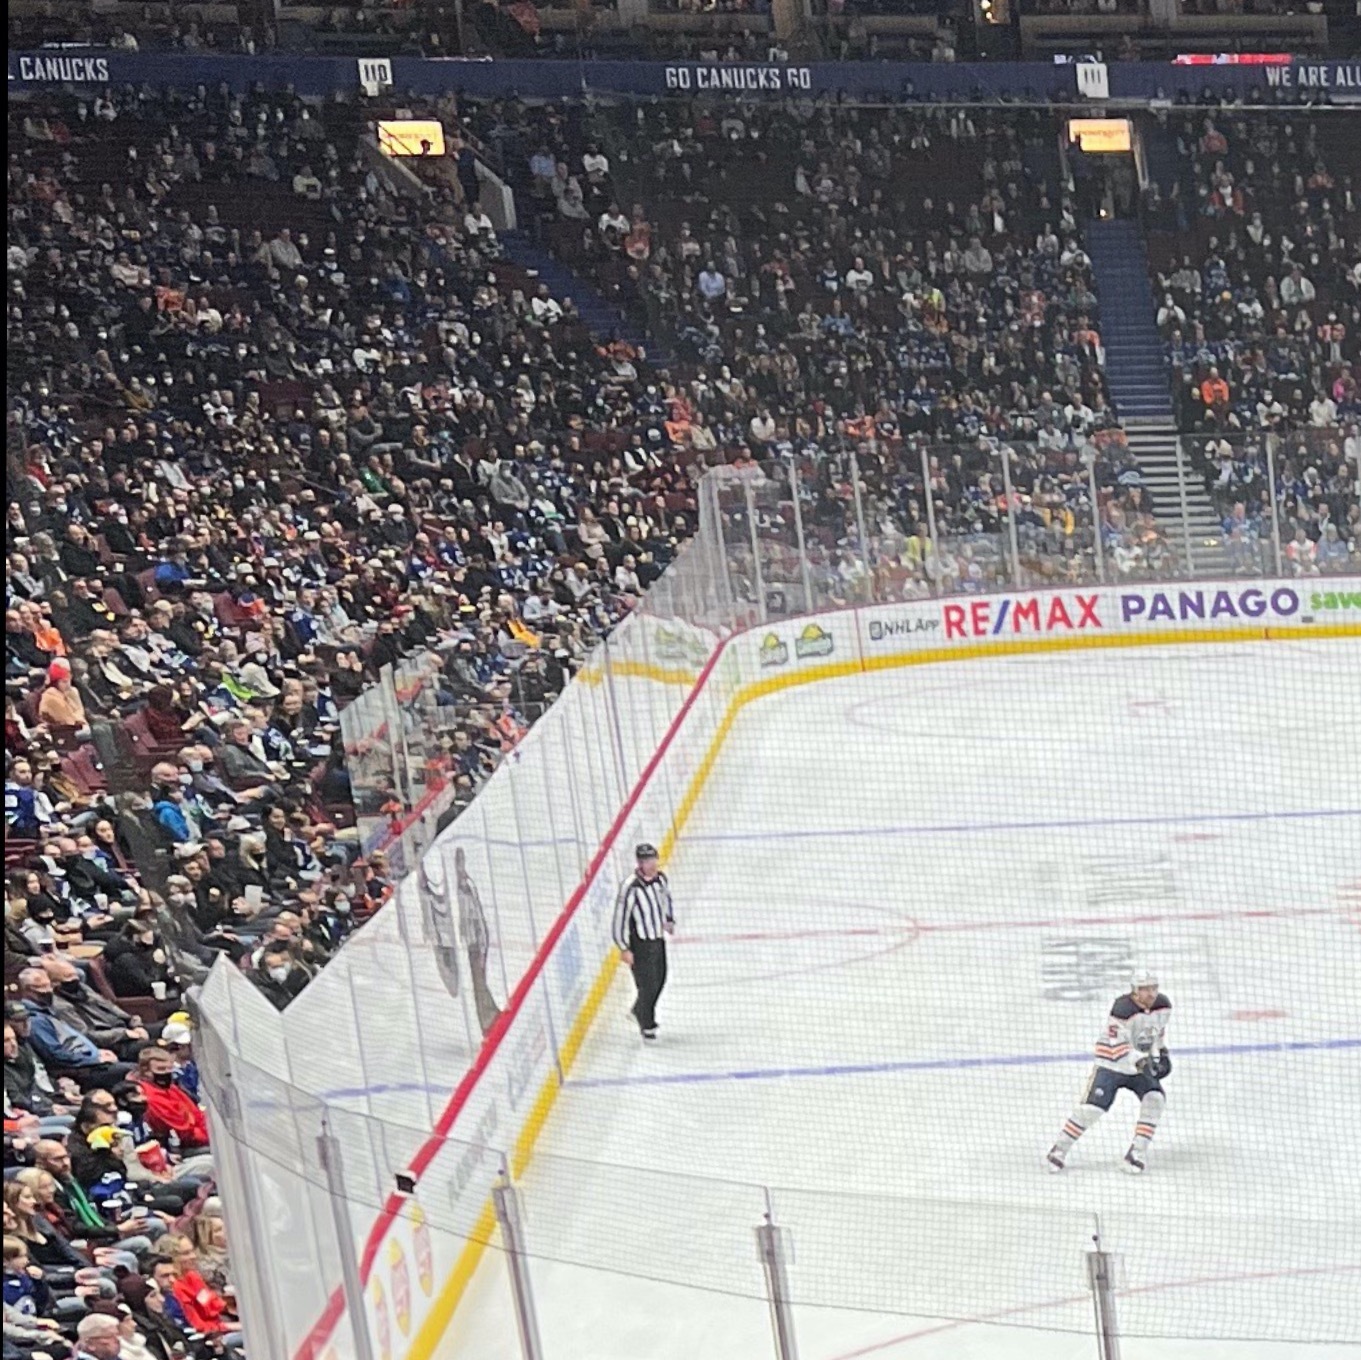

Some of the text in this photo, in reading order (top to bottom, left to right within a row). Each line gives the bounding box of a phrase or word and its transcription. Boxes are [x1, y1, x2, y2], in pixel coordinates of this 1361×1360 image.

[20, 57, 109, 81] CANUCKS
[363, 64, 388, 82] 110
[665, 67, 811, 89] GO CANUCKS GO
[1083, 68, 1101, 83] 111
[1265, 66, 1292, 87] WE
[1299, 66, 1330, 87] ARE
[943, 594, 1102, 638] RE/MAX
[1121, 588, 1299, 622] PANAGO
